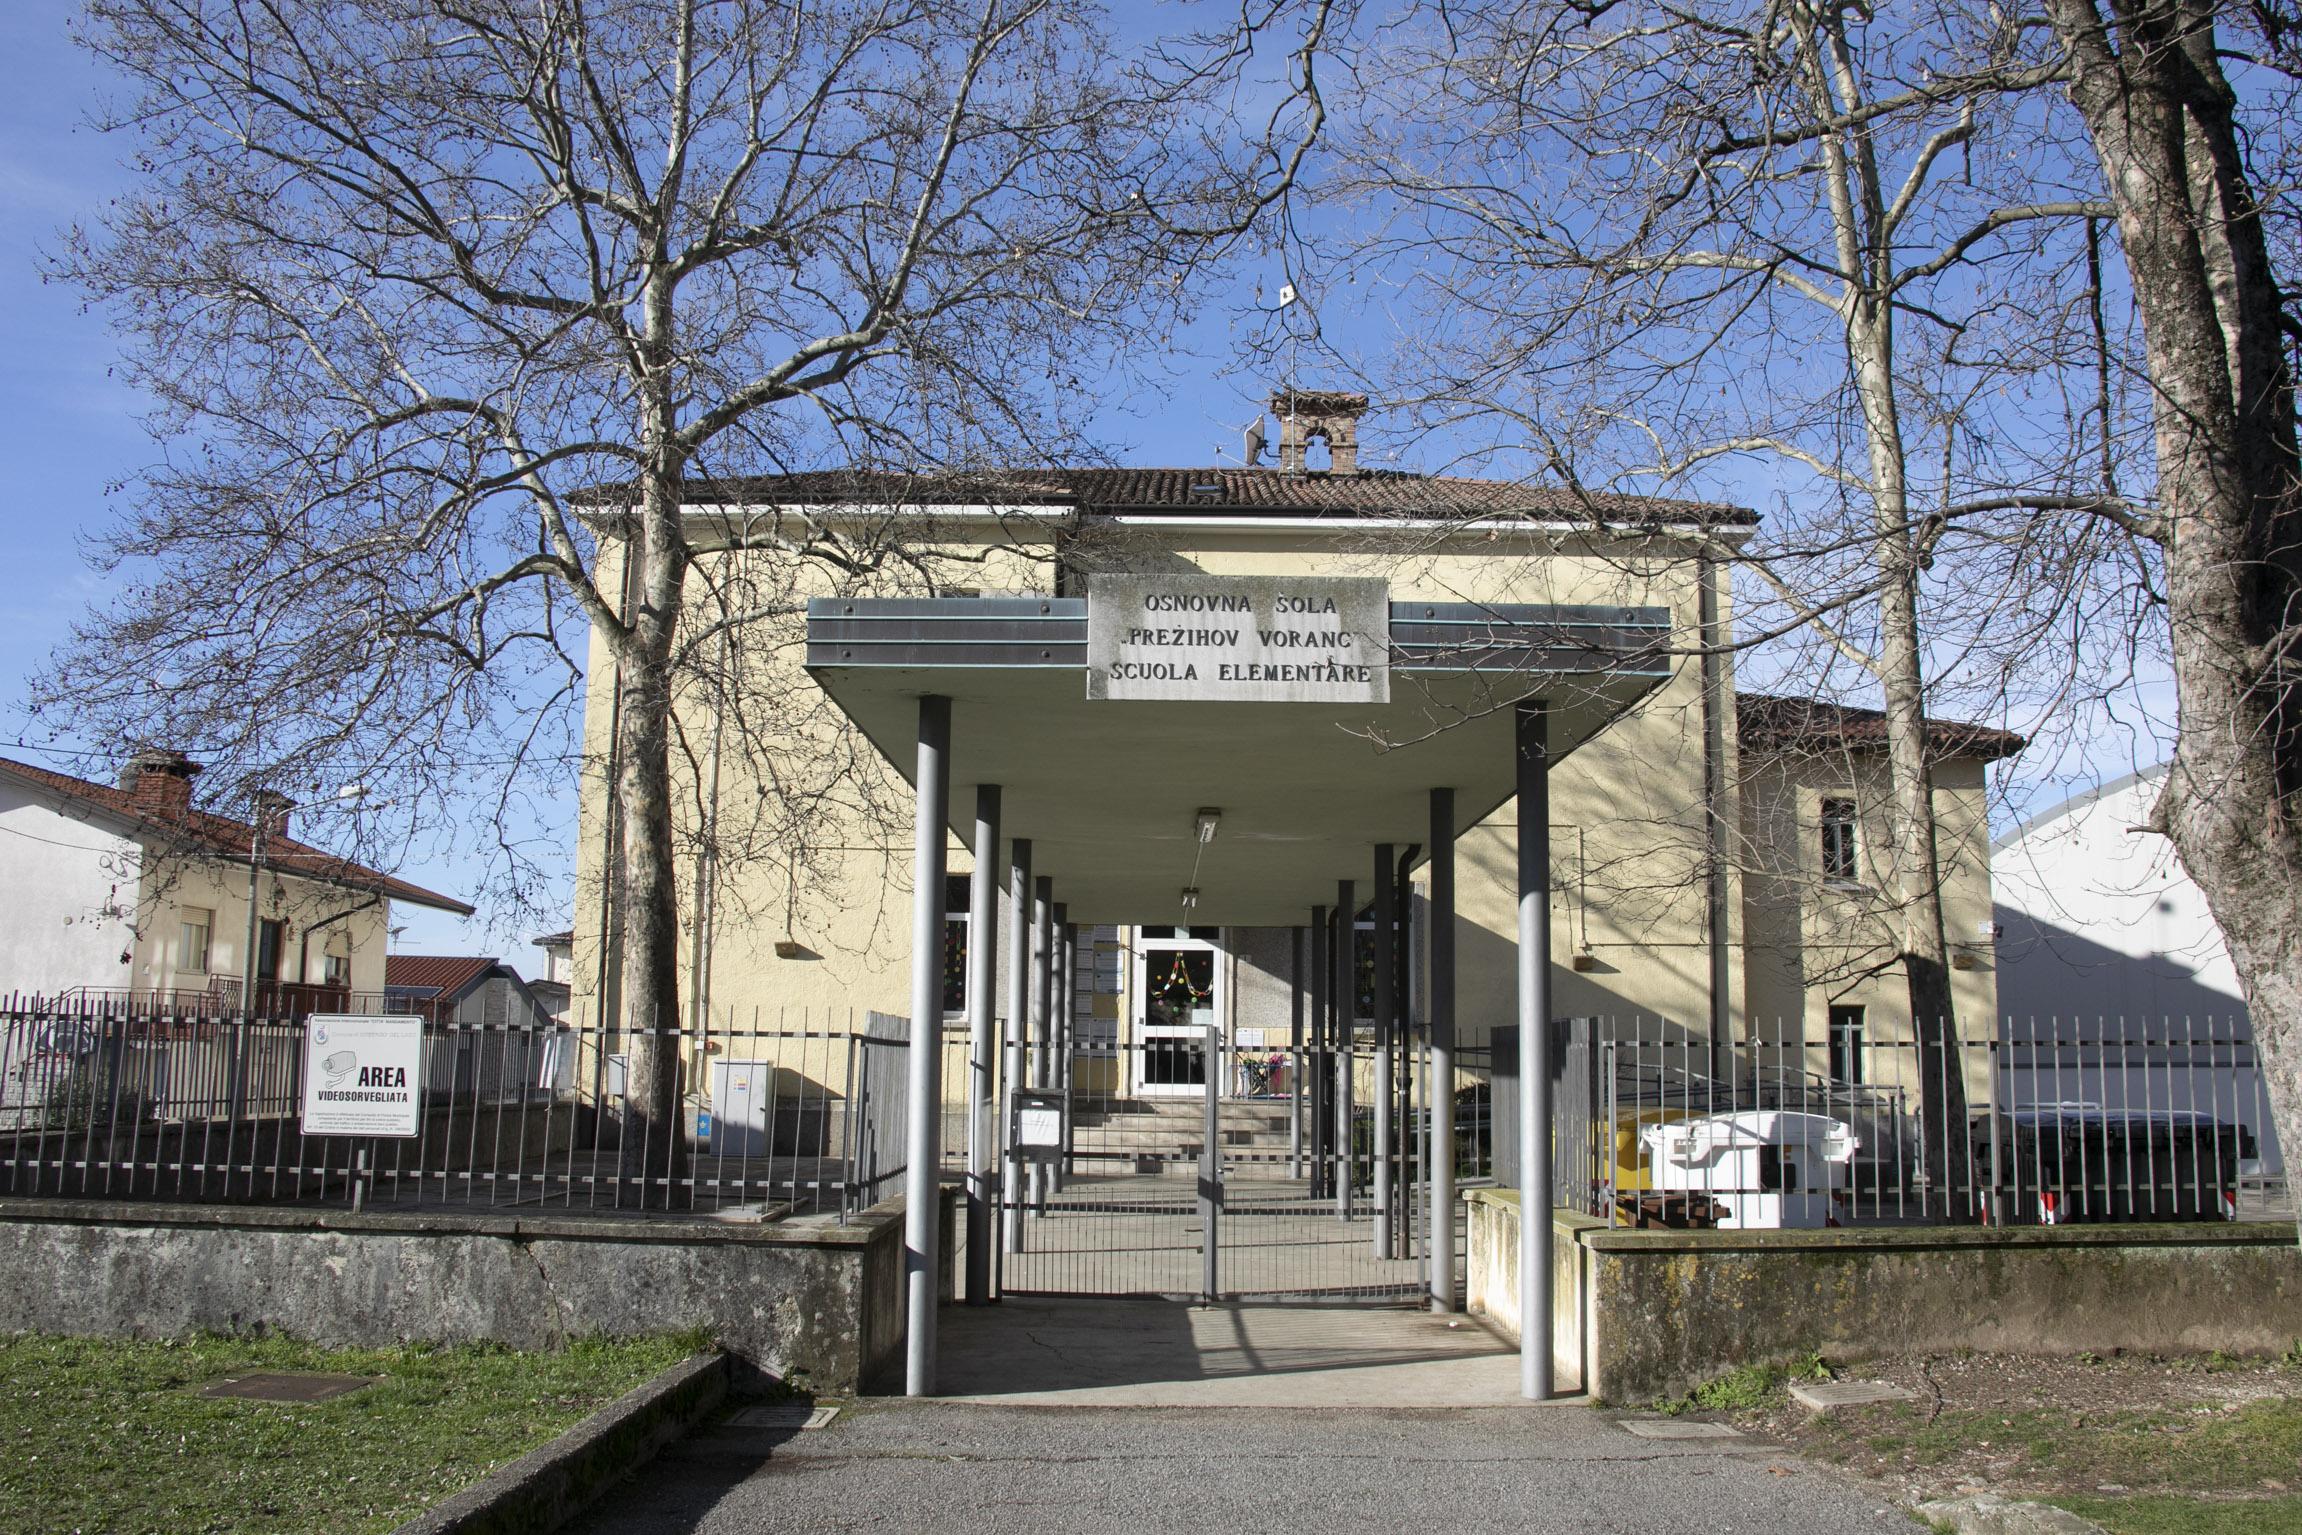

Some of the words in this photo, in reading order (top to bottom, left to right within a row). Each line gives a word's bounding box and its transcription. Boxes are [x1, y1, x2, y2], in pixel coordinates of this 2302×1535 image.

[1144, 594, 1251, 613] OSNOVNA
[1109, 662, 1198, 681] SCUOLA
[1218, 663, 1372, 683] ELEMENTARE
[358, 1066, 406, 1088] AREA
[318, 1090, 408, 1103] VIDEOSORVEGLIATA
